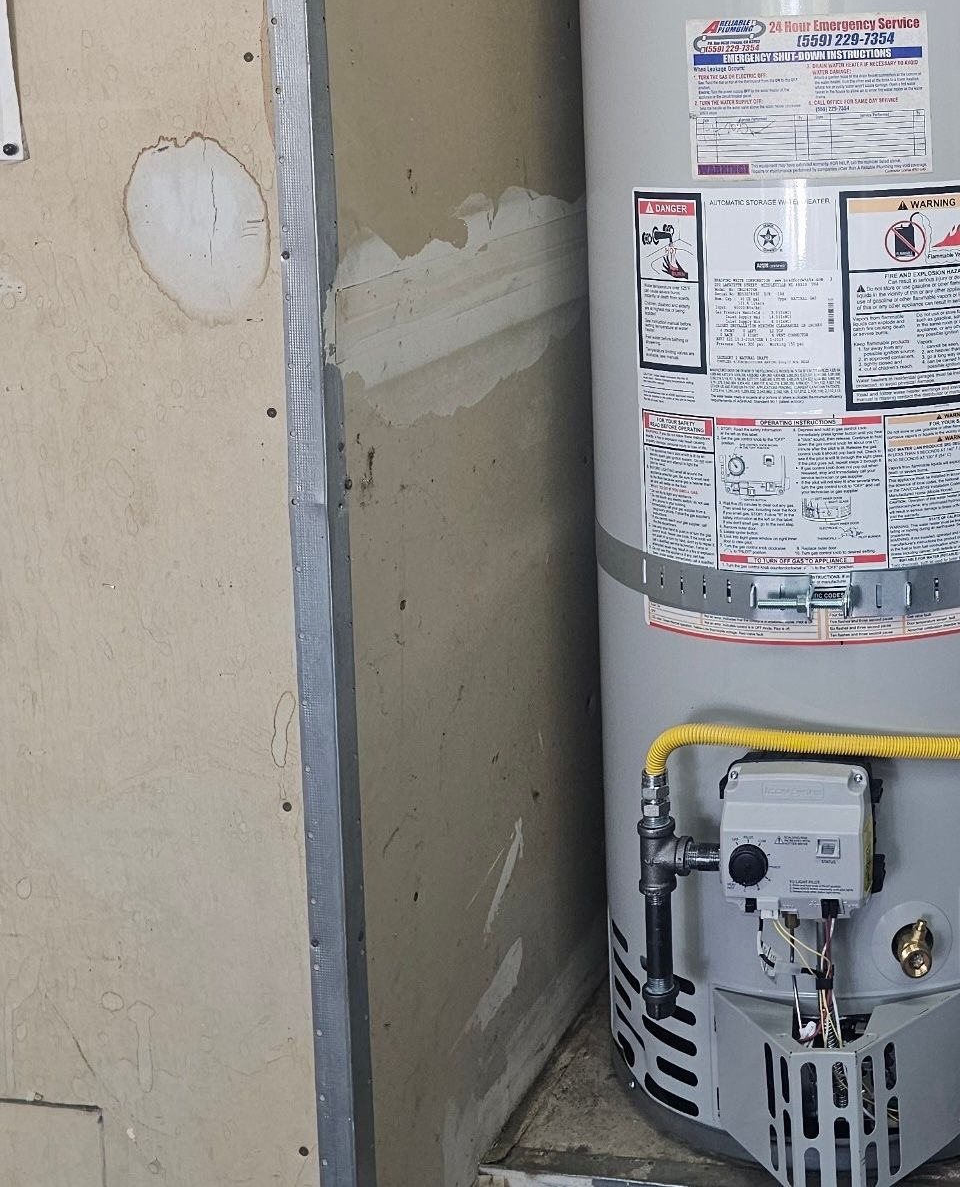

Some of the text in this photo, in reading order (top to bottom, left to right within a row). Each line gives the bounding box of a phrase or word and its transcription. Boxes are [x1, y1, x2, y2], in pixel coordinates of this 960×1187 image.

[702, 21, 720, 34] A
[718, 25, 754, 33] PLUMBING
[769, 17, 919, 33] 24 Hour Emergency Service
[797, 32, 895, 47] (559) 229-7354
[705, 44, 759, 53] (559) 229-7354
[723, 49, 891, 64] EMERGENCY SHUT-DOWN INSTRUCTIONS
[910, 198, 956, 209] WARNING
[655, 204, 687, 213] DANGER
[927, 252, 954, 260] Flammable
[913, 270, 946, 278] EXPLOSION
[678, 425, 704, 433] OPERATING
